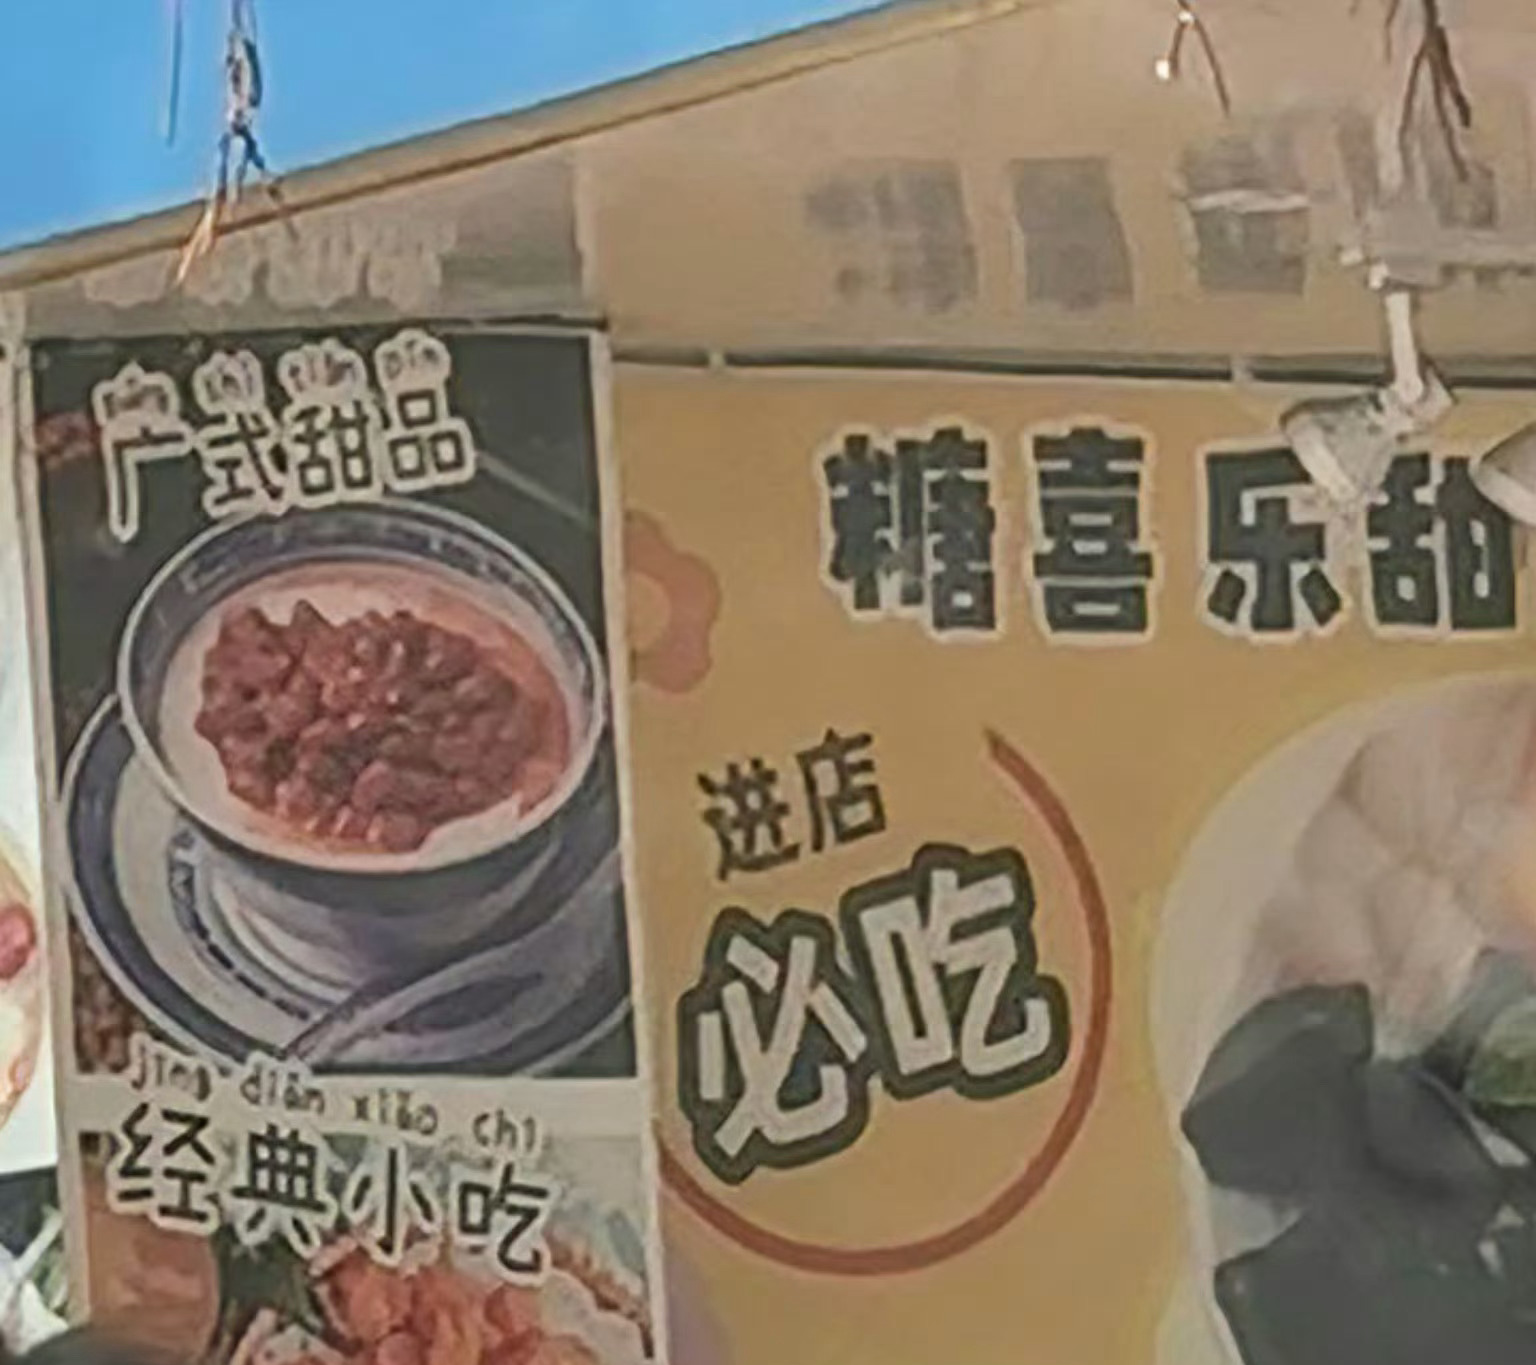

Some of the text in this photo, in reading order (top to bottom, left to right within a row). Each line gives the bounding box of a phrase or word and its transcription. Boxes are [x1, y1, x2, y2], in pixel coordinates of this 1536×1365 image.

[106, 390, 466, 533] 广式甜品
[697, 728, 887, 880] 进店
[684, 853, 1063, 1174] 必吃
[117, 1100, 550, 1275] 经典小吃
